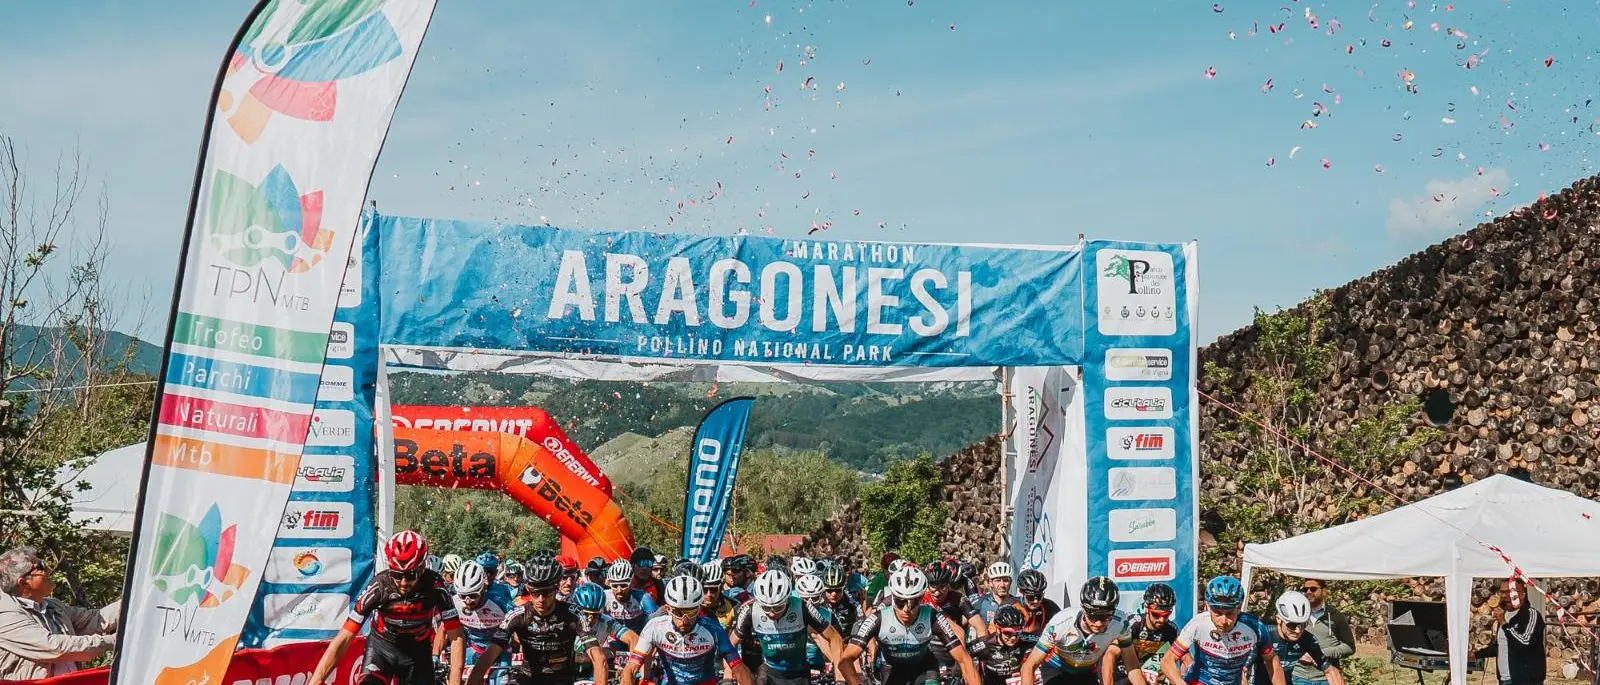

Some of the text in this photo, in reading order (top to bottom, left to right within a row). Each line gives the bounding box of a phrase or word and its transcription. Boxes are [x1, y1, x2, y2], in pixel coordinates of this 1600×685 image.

[793, 241, 915, 264] MARATHON
[210, 264, 286, 306] TPN
[547, 249, 972, 338] ARAGONESI
[193, 321, 263, 351] Trofeo
[637, 335, 893, 362] POLLINO NATIONAL PARK
[180, 402, 259, 433] Naturali
[171, 441, 212, 465] Mtb
[1135, 433, 1163, 448] fim
[393, 438, 497, 478] Beta
[555, 448, 600, 487] ENERVIT
[537, 477, 594, 529] Beta
[303, 510, 340, 528] fim
[1131, 561, 1168, 573] ENERVIT
